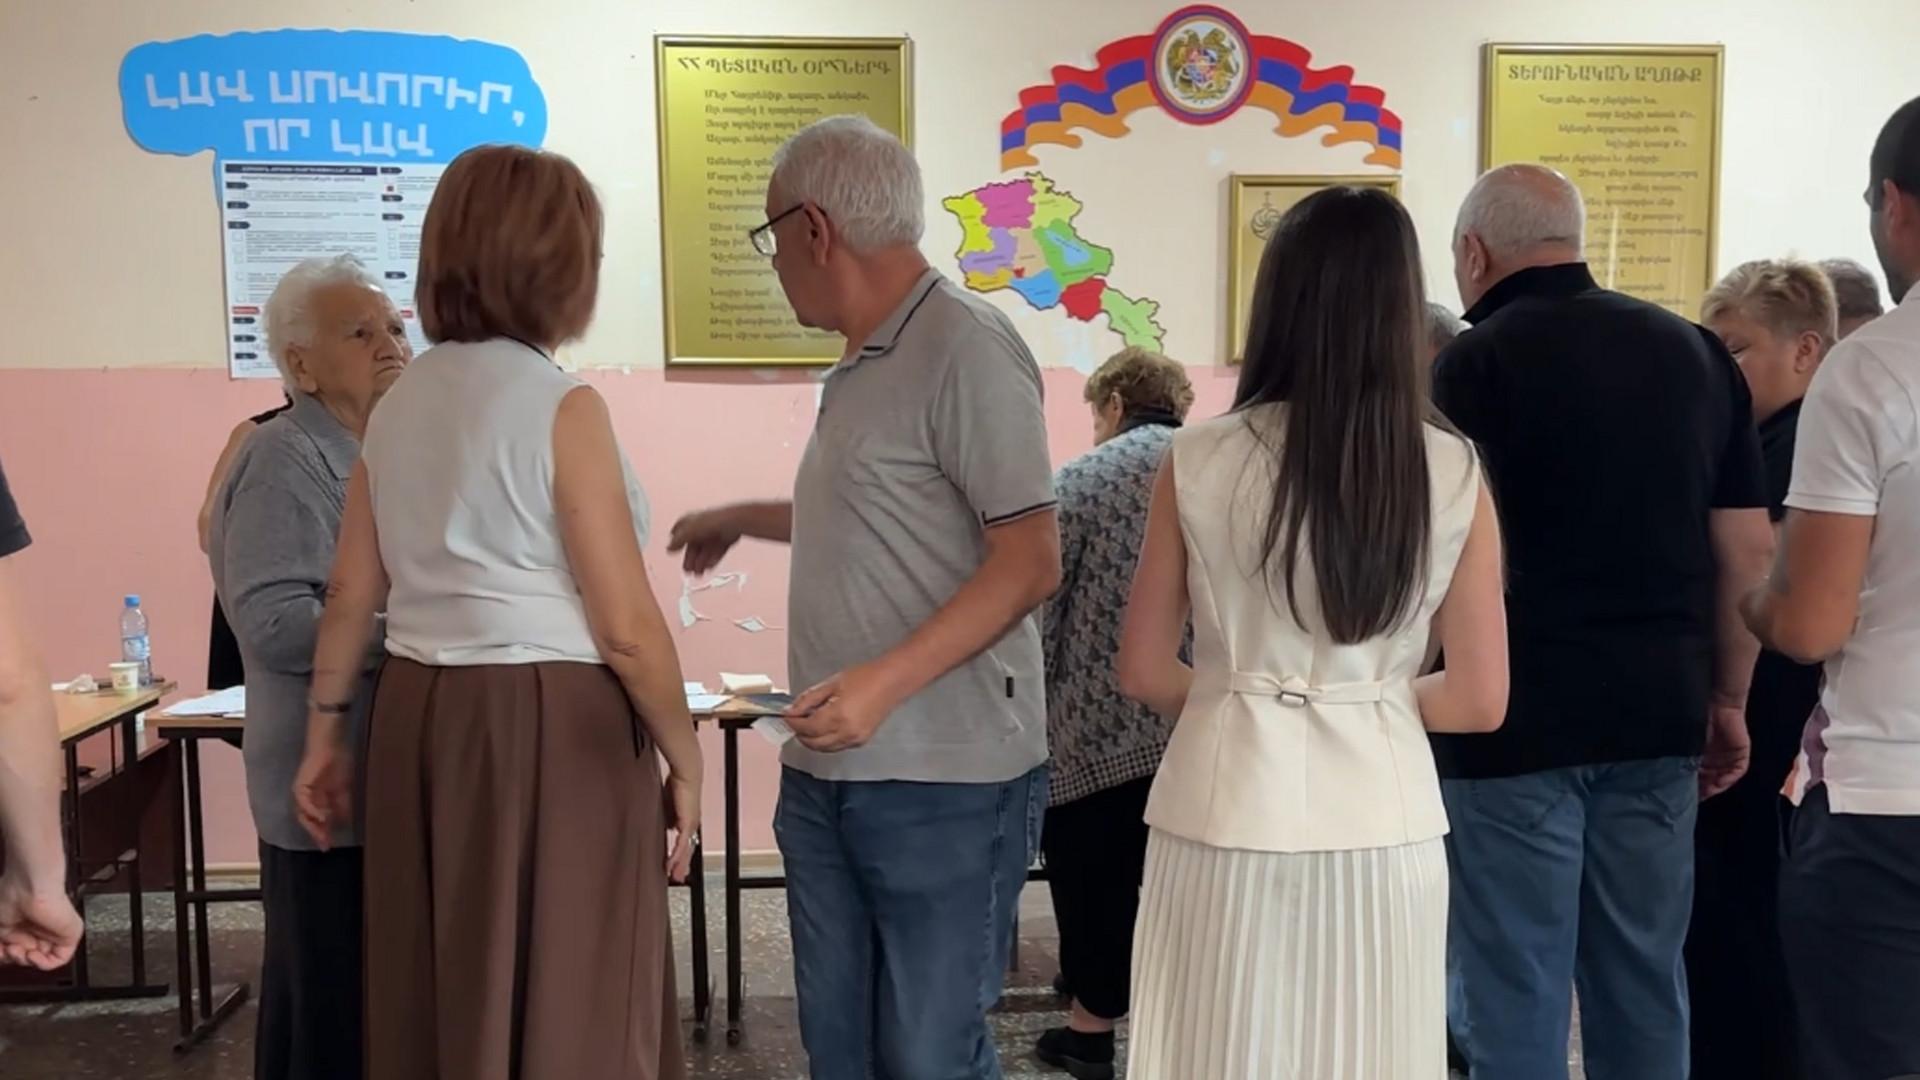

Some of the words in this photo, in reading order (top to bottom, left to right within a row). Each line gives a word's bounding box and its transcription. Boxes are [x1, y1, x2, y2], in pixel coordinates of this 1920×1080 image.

[677, 56, 702, 71] ՀՀ
[705, 56, 798, 75] ՊԵՏԱԿԱՆ
[802, 57, 892, 76] ՕՐՀՆԵՐԳ
[1508, 63, 1629, 81] ՏԵՐՈՒՆԱԿԱՆ
[1634, 65, 1702, 83] ԱՂՈԹՔ
[145, 69, 255, 110] ԼԱՎ
[269, 69, 526, 127] ՍՈՎՈՐԻՐ,
[243, 118, 311, 152] ՈՐ
[331, 118, 434, 157] ԼԱՎ
